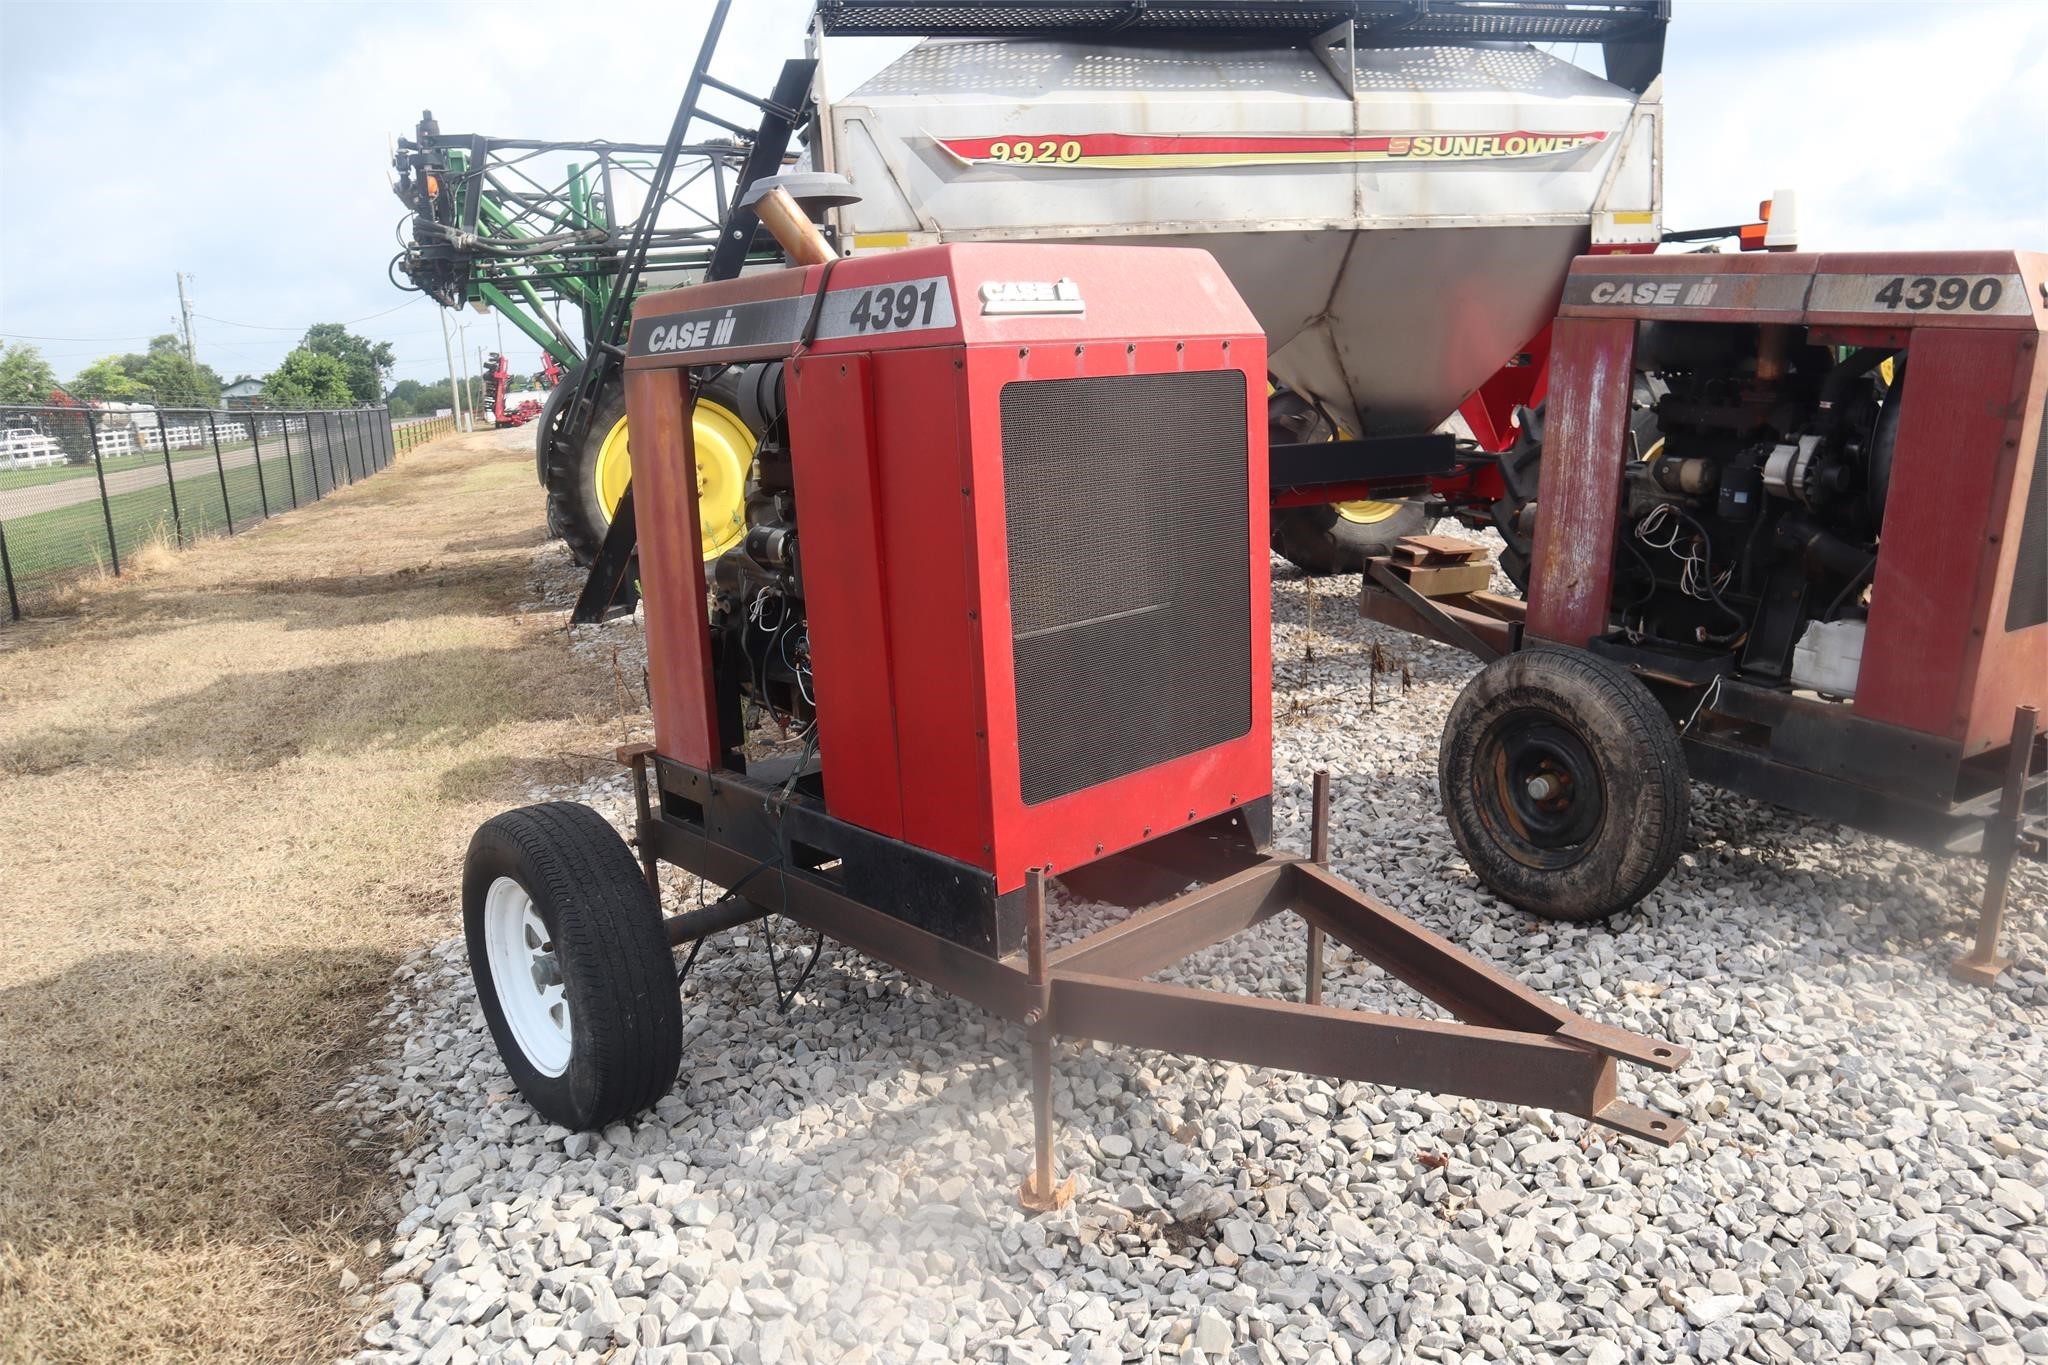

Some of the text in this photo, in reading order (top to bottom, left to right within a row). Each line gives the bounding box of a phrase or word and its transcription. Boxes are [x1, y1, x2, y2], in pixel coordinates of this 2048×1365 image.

[989, 141, 1082, 163] 9920
[849, 281, 939, 332] 4391
[1590, 281, 1682, 306] CASE
[1875, 277, 2003, 312] 4390
[648, 320, 708, 353] CASE
